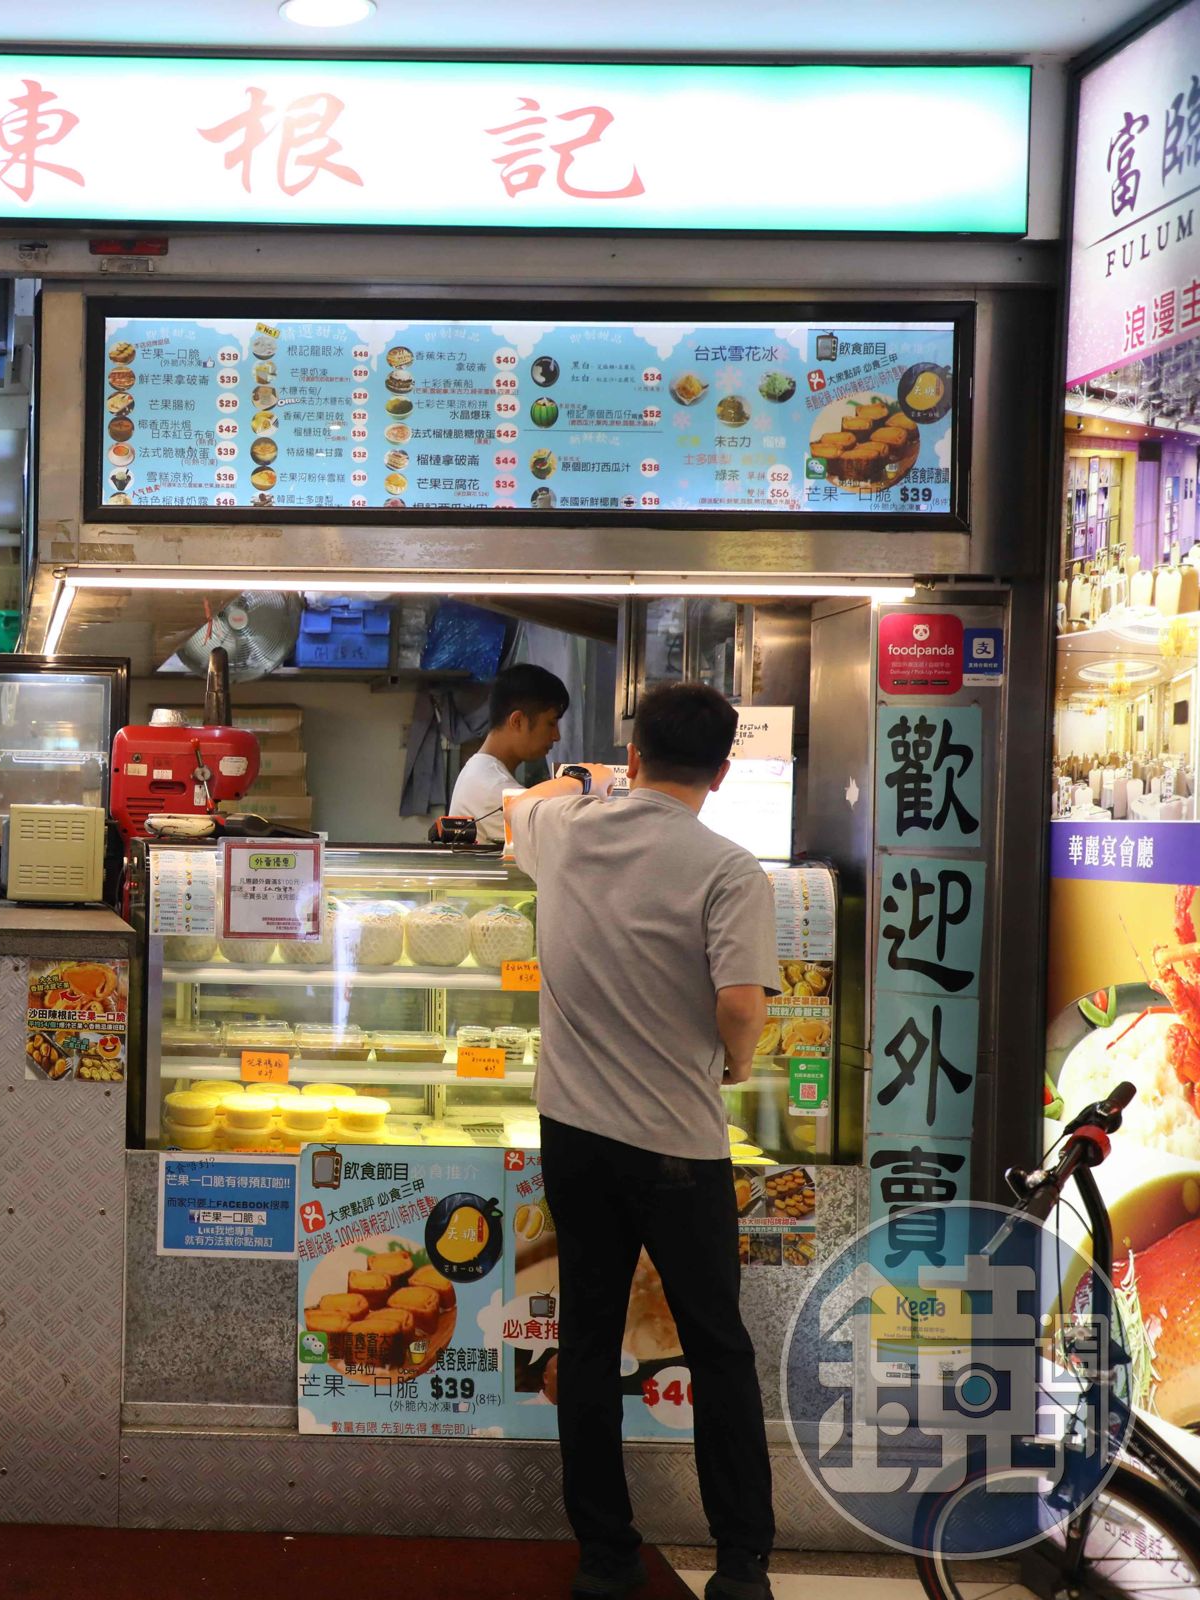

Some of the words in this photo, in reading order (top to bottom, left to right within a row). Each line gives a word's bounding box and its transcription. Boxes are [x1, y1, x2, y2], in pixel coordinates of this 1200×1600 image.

[1105, 208, 1196, 279] FULUM
[694, 345, 779, 361] 台式雪花冰
[839, 342, 886, 356] 飲食節目
[220, 353, 239, 361] $39
[496, 356, 516, 364] $40
[219, 376, 238, 384] $39
[643, 373, 662, 381] $34
[218, 400, 238, 408] $29
[496, 404, 516, 412] $34
[643, 410, 662, 418] $52
[218, 425, 238, 433] $42
[496, 430, 516, 438] $42
[217, 448, 236, 456] $39
[495, 456, 516, 464] $44
[641, 463, 660, 472] $38
[216, 473, 235, 481] $36
[495, 480, 515, 489] $34
[805, 486, 892, 502] 芒果一口脆
[900, 487, 932, 502] $39
[641, 496, 660, 505] $38
[887, 644, 955, 658] foodpanda
[1067, 834, 1155, 869] 華麗宴會廳
[871, 714, 980, 1269] 歡迎外賣
[343, 1161, 409, 1182] 飲食節目
[202, 1211, 254, 1223] 芒果一口脆
[345, 1362, 377, 1376] 第4位
[299, 1374, 419, 1400] 芒果一口脆
[430, 1373, 476, 1400] $39
[475, 1393, 502, 1407] (8件)
[331, 1421, 378, 1434] 數量有限
[381, 1421, 427, 1435] 先到先得
